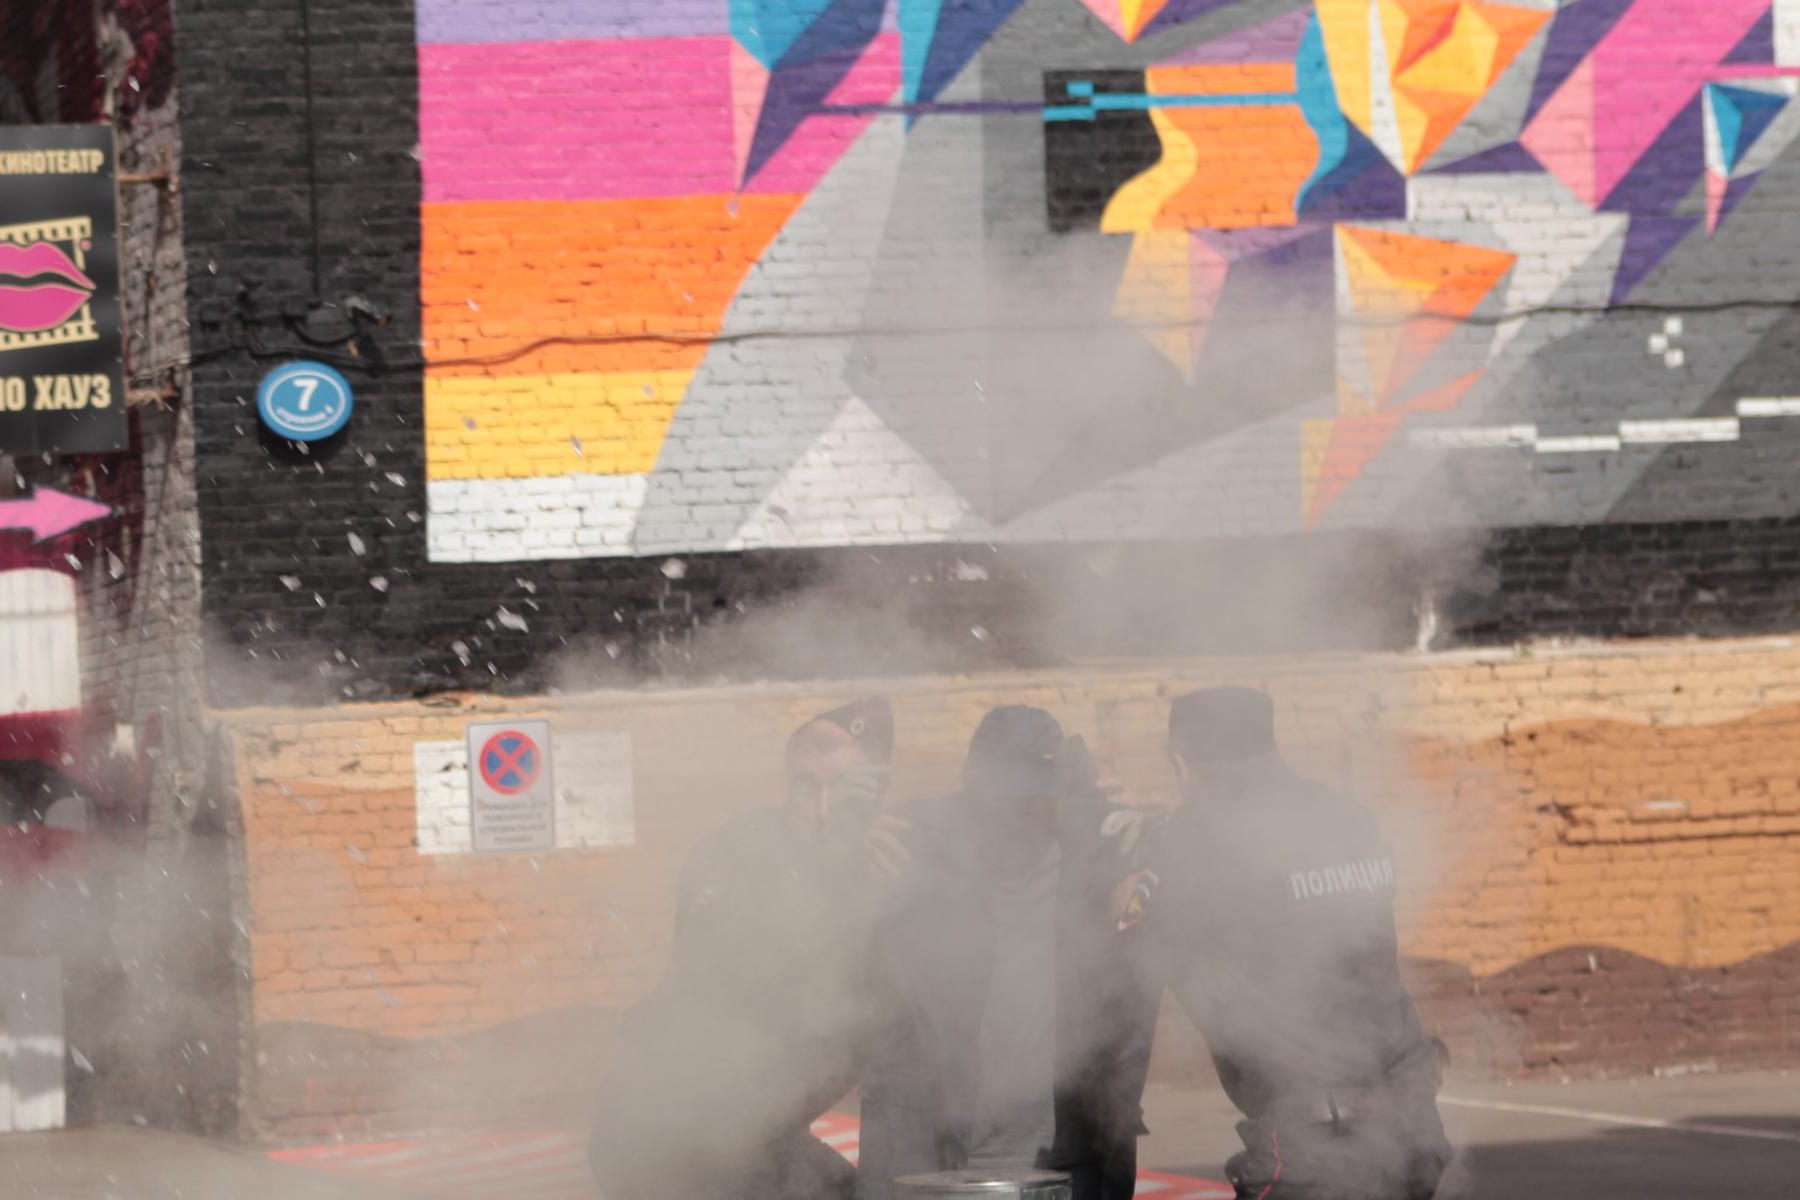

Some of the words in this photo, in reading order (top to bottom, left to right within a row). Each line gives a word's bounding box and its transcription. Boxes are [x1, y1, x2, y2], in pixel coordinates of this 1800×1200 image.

[33, 373, 112, 410] ХАУЗ
[293, 378, 319, 411] 7
[1290, 858, 1392, 900] ПОЛИЦИЯ
